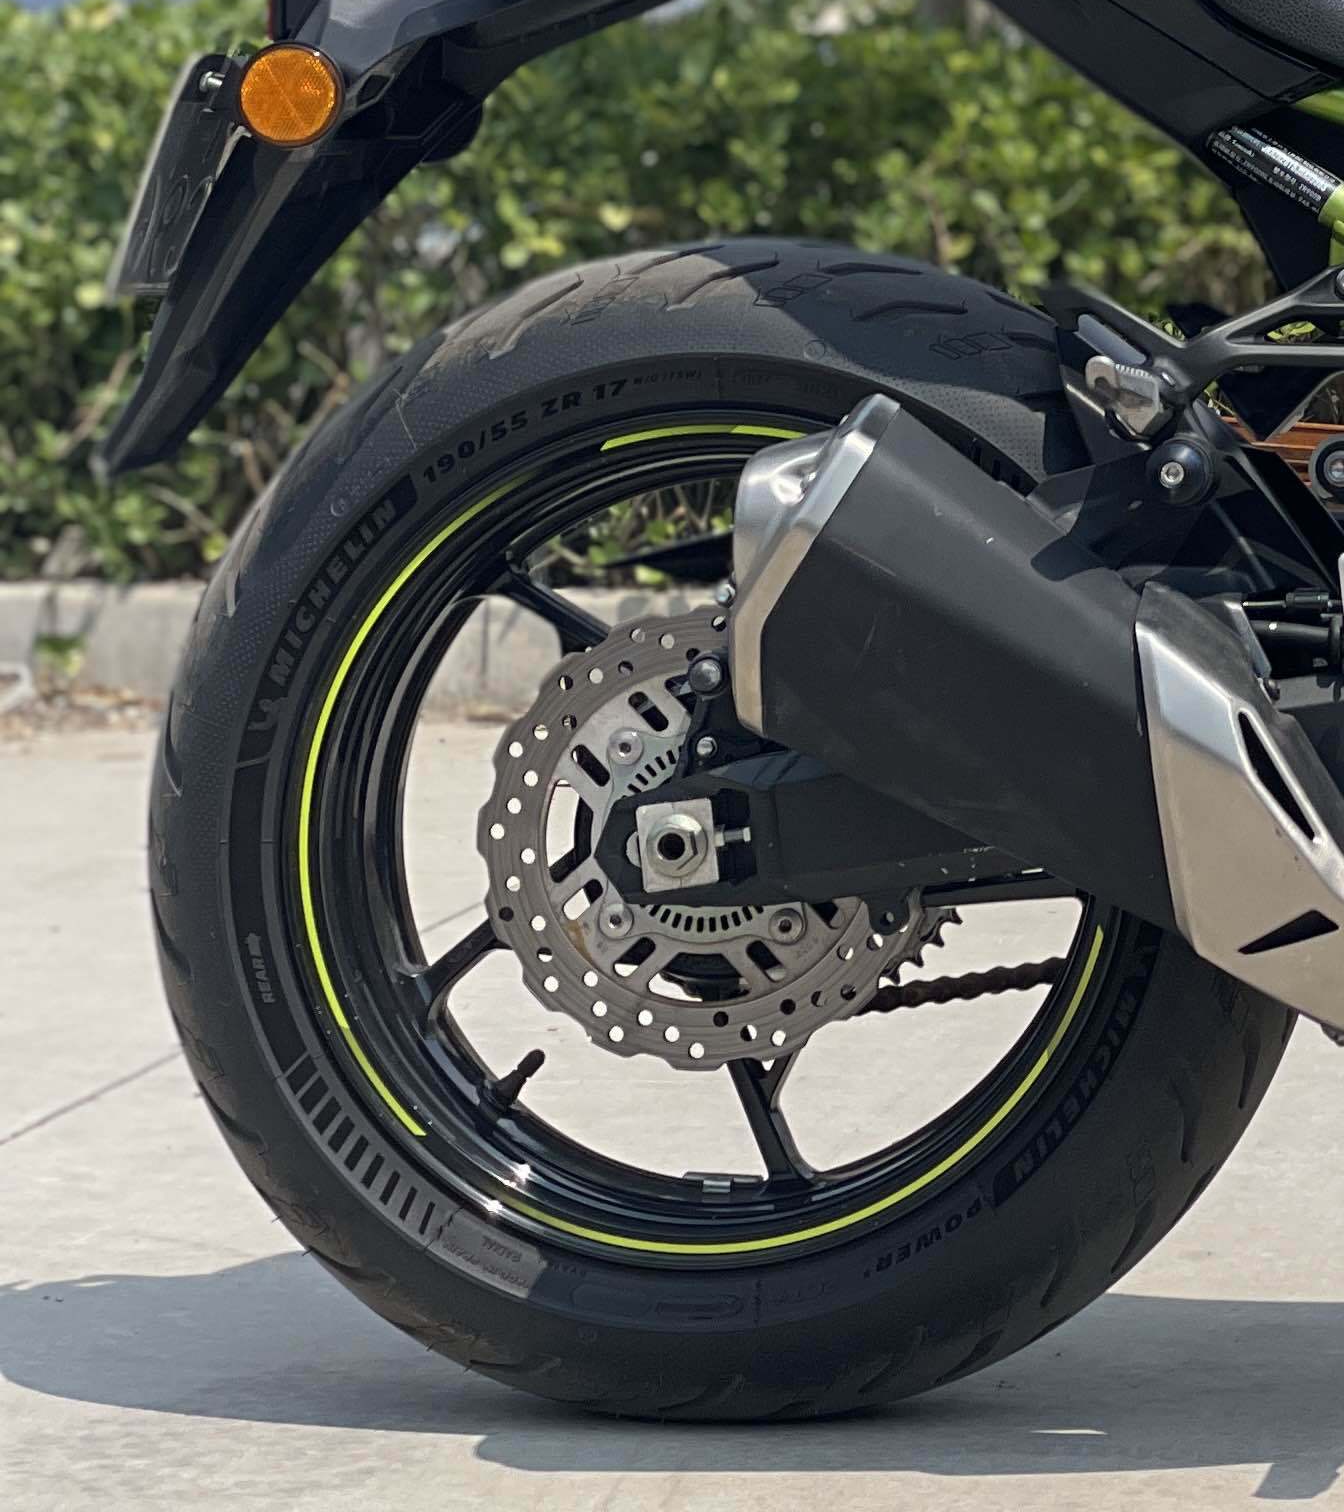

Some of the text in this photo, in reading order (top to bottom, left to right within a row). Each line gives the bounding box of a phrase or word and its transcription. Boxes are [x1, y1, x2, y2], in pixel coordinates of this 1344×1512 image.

[265, 494, 399, 688] MICHELIN
[419, 409, 530, 485] 190/55
[536, 390, 584, 419] ZR
[591, 378, 629, 401] 17
[250, 955, 276, 1005] REAR
